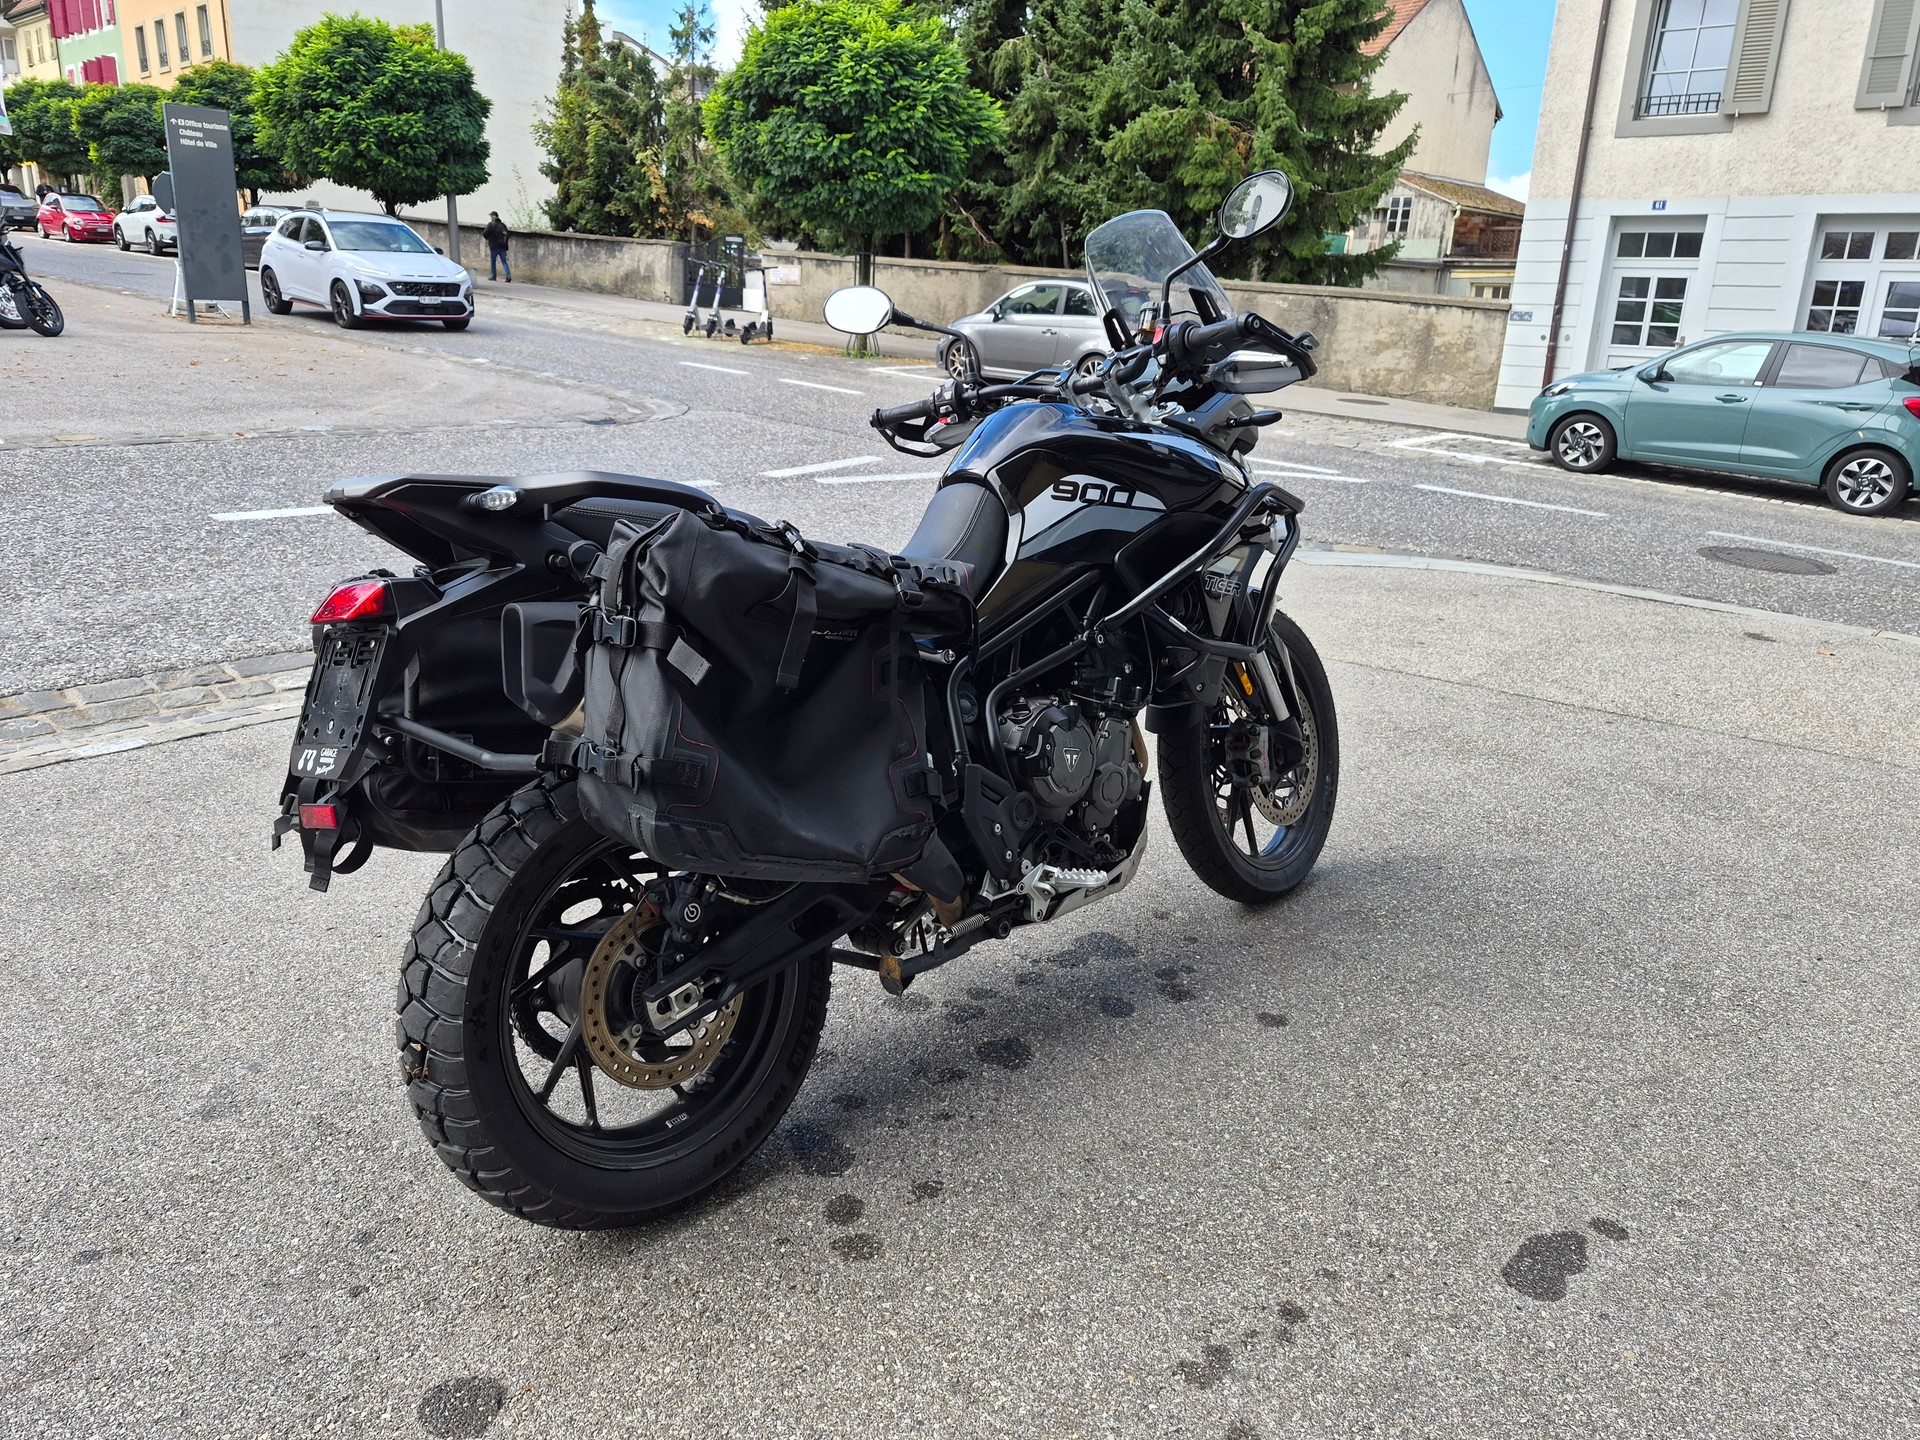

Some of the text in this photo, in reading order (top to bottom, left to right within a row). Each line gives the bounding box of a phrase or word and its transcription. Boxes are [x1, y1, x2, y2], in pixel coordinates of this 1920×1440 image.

[184, 120, 228, 131] Office tourisme
[179, 128, 203, 138] Château
[180, 138, 196, 146] Hôtel
[204, 140, 218, 149] Ville
[1050, 480, 1137, 507] 900
[1204, 575, 1243, 596] TIGER
[320, 747, 339, 757] GARAGE
